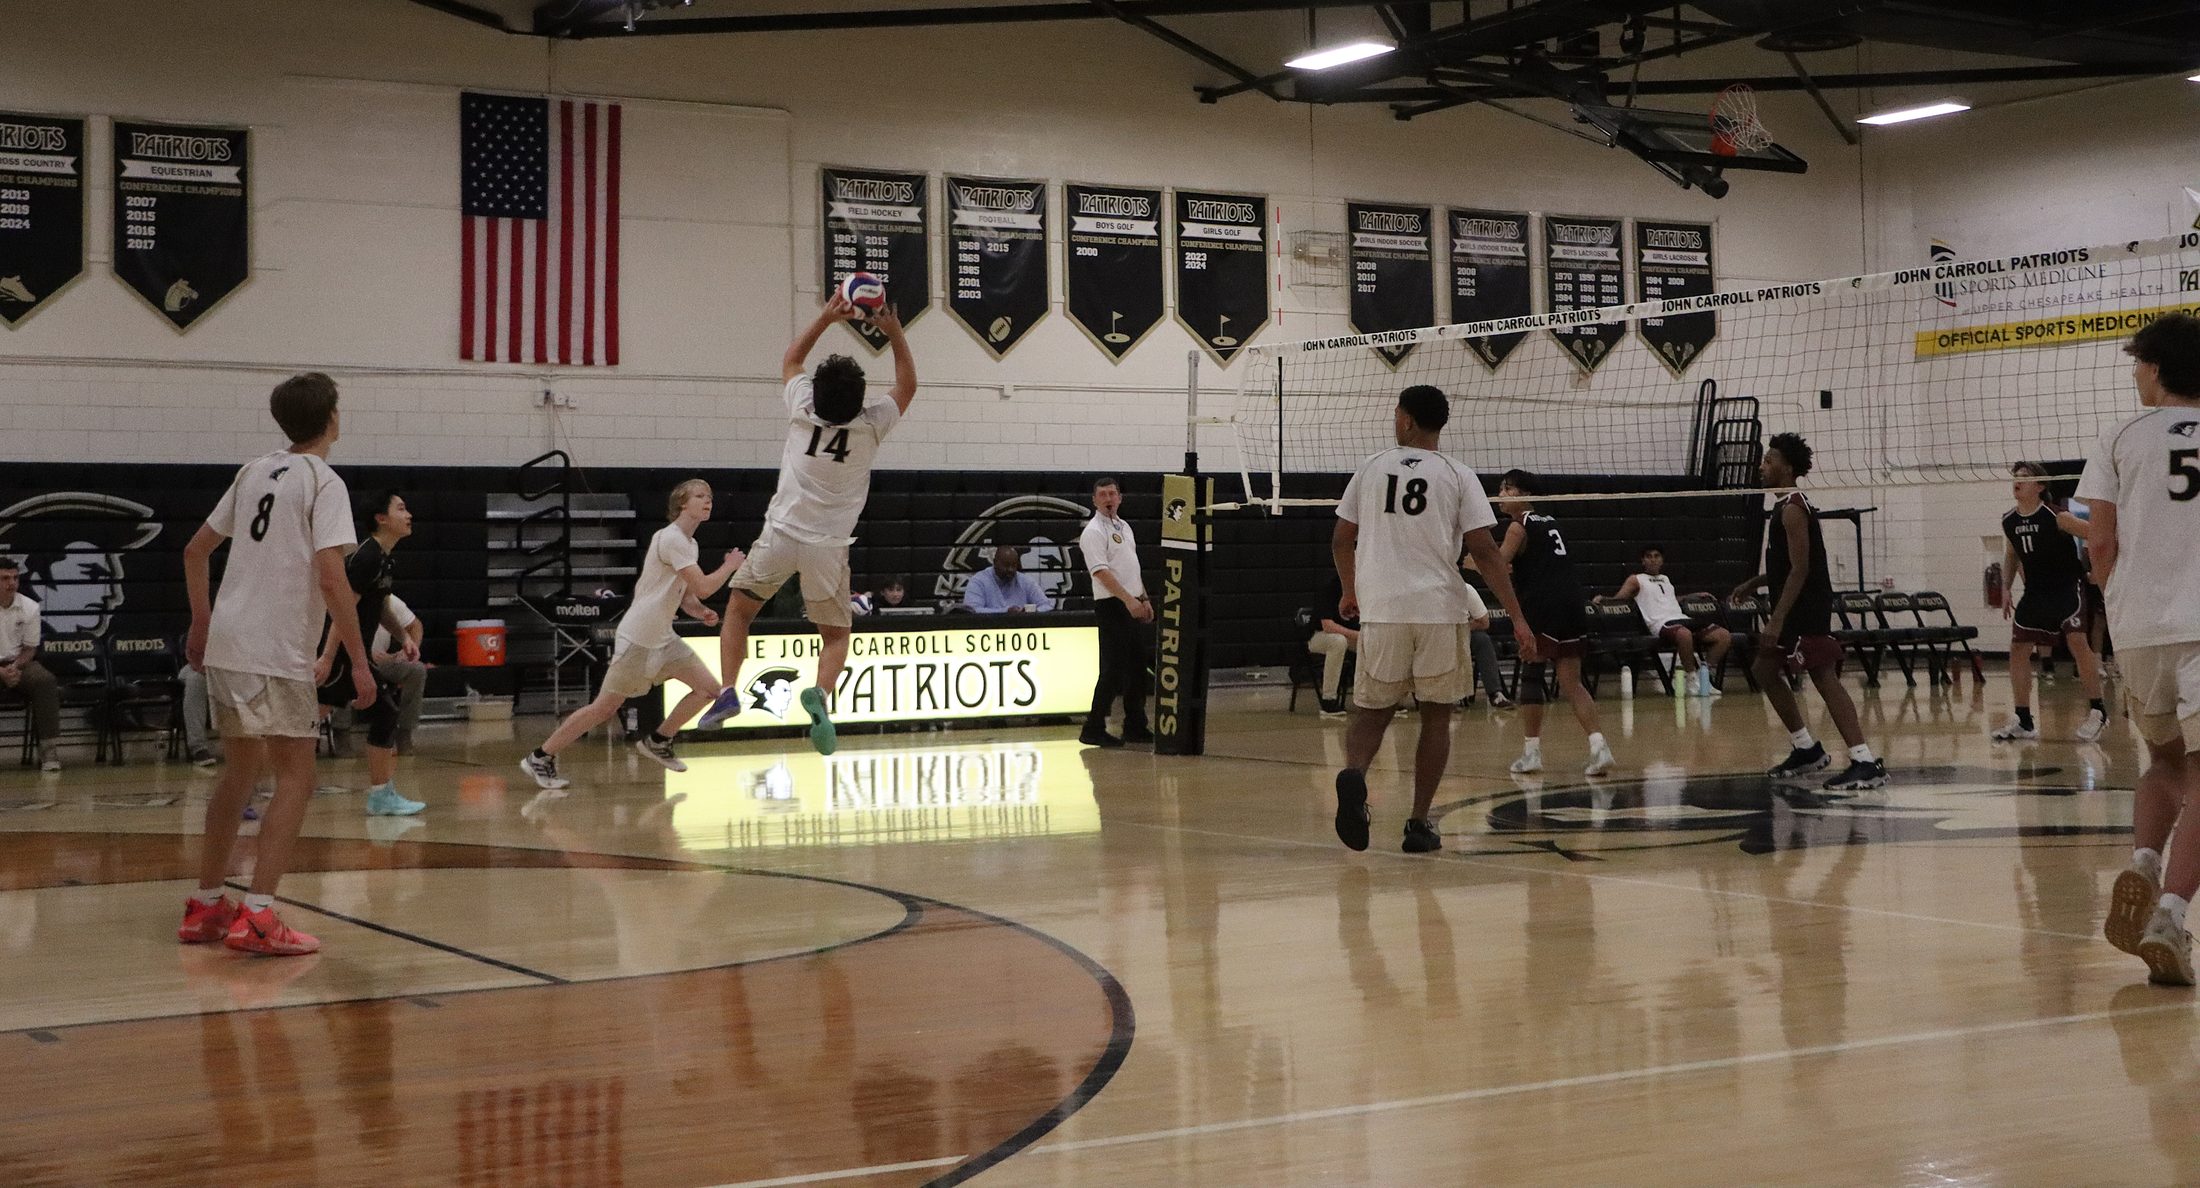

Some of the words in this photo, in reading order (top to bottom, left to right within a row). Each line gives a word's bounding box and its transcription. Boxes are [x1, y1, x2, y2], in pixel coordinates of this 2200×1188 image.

[0, 124, 66, 151] RIOTS
[131, 132, 232, 161] PATRIOTS
[0, 157, 20, 166] OSS
[23, 158, 67, 168] COUNTRY
[151, 166, 213, 177] EQUESTRIAN
[17, 175, 78, 188] CHAMPIONS
[0, 188, 30, 200] 2013
[120, 181, 182, 193] CONFERENCE
[185, 185, 242, 196] CHAMPIONS
[836, 177, 915, 203] PATRIOTS
[126, 196, 157, 207] 2007
[960, 185, 1035, 210] PATRIOTS
[1079, 193, 1151, 217] PATRIOTS
[126, 210, 156, 221] 2015
[847, 206, 869, 215] FIELD
[871, 208, 903, 217] HOCKEY
[1187, 200, 1256, 223] PATRIOTS
[0, 218, 31, 229] 2024
[978, 215, 1017, 224] FOOTBALL
[1359, 211, 1422, 233] PATRIOTS
[126, 225, 156, 236] 2016
[878, 225, 923, 233] CHAMPIONS
[1117, 223, 1134, 231] GOLF
[1203, 227, 1222, 235] GIRLS
[1459, 217, 1520, 240] PATRIOTS
[1001, 231, 1043, 240] CHAMPIONS
[1072, 235, 1117, 244] CONFERENCE
[1117, 238, 1159, 246] CHAMPIONS
[1555, 224, 1614, 245] PATRIOTS
[1646, 229, 1703, 249] PATRIOTS
[127, 239, 156, 250] 2017
[865, 236, 889, 246] 2015
[958, 241, 981, 250] 1968
[987, 243, 1009, 252] 2015
[1181, 240, 1224, 249] CONFERENCE
[1225, 243, 1264, 252] CHAMPIONS
[1399, 239, 1422, 247] SOCCER
[834, 247, 857, 256] 1996
[865, 248, 889, 258] 2016
[958, 253, 980, 262] 1969
[1185, 252, 1207, 261] 2023
[1669, 254, 1698, 262] LACROSSE
[834, 259, 857, 268] 1999
[865, 261, 889, 271] 2019
[1185, 261, 1206, 270] 2024
[1893, 268, 1931, 285] JOHN
[1935, 260, 2006, 279] CARROLL
[2011, 248, 2090, 270] PATRIOTS
[958, 278, 981, 287] 2001
[1357, 273, 1377, 282] 2010
[1555, 272, 1573, 281] 1970
[1959, 274, 2017, 296] SPORTS
[2024, 264, 2107, 287] MEDICINE
[958, 290, 982, 299] 2003
[1358, 284, 1377, 293] 2017
[1662, 298, 1692, 313] JOHN
[1696, 291, 1754, 308] CARROLL
[1758, 282, 1821, 301] PATRIOTS
[1973, 301, 2014, 314] UPPER
[2019, 290, 2103, 311] CHESAPEAKE
[2110, 284, 2164, 298] HEALTH
[1467, 321, 1494, 335] JOHN
[1497, 315, 1545, 331] CARROLL
[1548, 309, 1601, 325] PATRIOTS
[1938, 329, 2011, 348] OFFICIAL
[2015, 320, 2076, 340] SPORTS
[2082, 311, 2165, 333] MEDICIN
[1303, 340, 1325, 351] JOHN
[1327, 335, 1369, 349] CARROLL
[1372, 330, 1417, 344] PATRIOTS
[804, 425, 852, 463] 14
[2167, 448, 2200, 502] 5
[1384, 473, 1428, 516] 18
[250, 493, 275, 542] 8
[1548, 529, 1567, 555] 3
[2021, 535, 2034, 554] 11
[1658, 583, 1666, 595] 1
[556, 604, 600, 616] molten
[44, 640, 95, 652] PATRIOTS
[116, 639, 165, 651] PATRIOTS
[488, 636, 497, 647] G
[780, 638, 821, 659] JOH
[852, 634, 953, 656] CARROLL
[966, 632, 1051, 653] SCHOOL
[1159, 559, 1183, 736] PATRIOTS
[831, 659, 1037, 714] PATRIOTS
